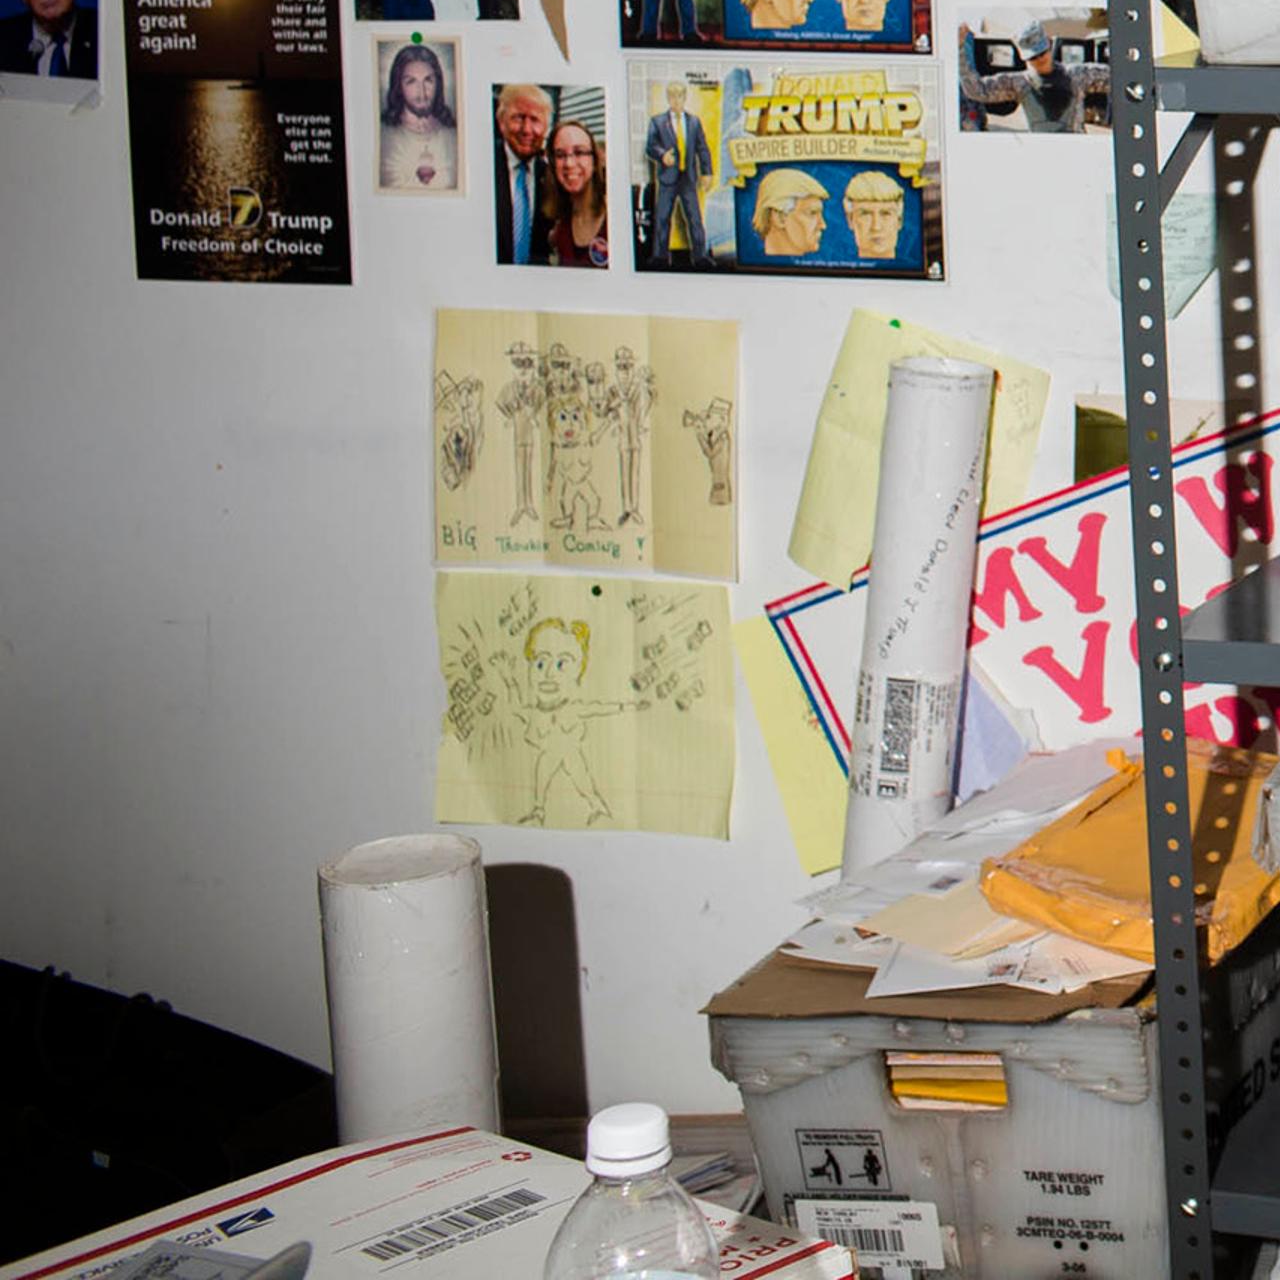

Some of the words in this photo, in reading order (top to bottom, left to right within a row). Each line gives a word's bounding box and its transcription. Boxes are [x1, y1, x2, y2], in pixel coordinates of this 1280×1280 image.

[139, 13, 187, 34] great
[140, 33, 197, 55] again!
[743, 91, 923, 137] TRUMP
[735, 138, 791, 160] EMPIRE
[794, 137, 858, 156] BUILDER
[150, 209, 221, 228] Donald
[268, 211, 333, 233] Trump
[162, 235, 236, 255] Freedom
[241, 236, 260, 254] of
[264, 237, 324, 257] Choice
[1024, 1171, 1055, 1183] TARE
[1057, 1172, 1104, 1185] WEIGHT
[1066, 1184, 1091, 1196] LBS
[1027, 1216, 1054, 1227] PSIN
